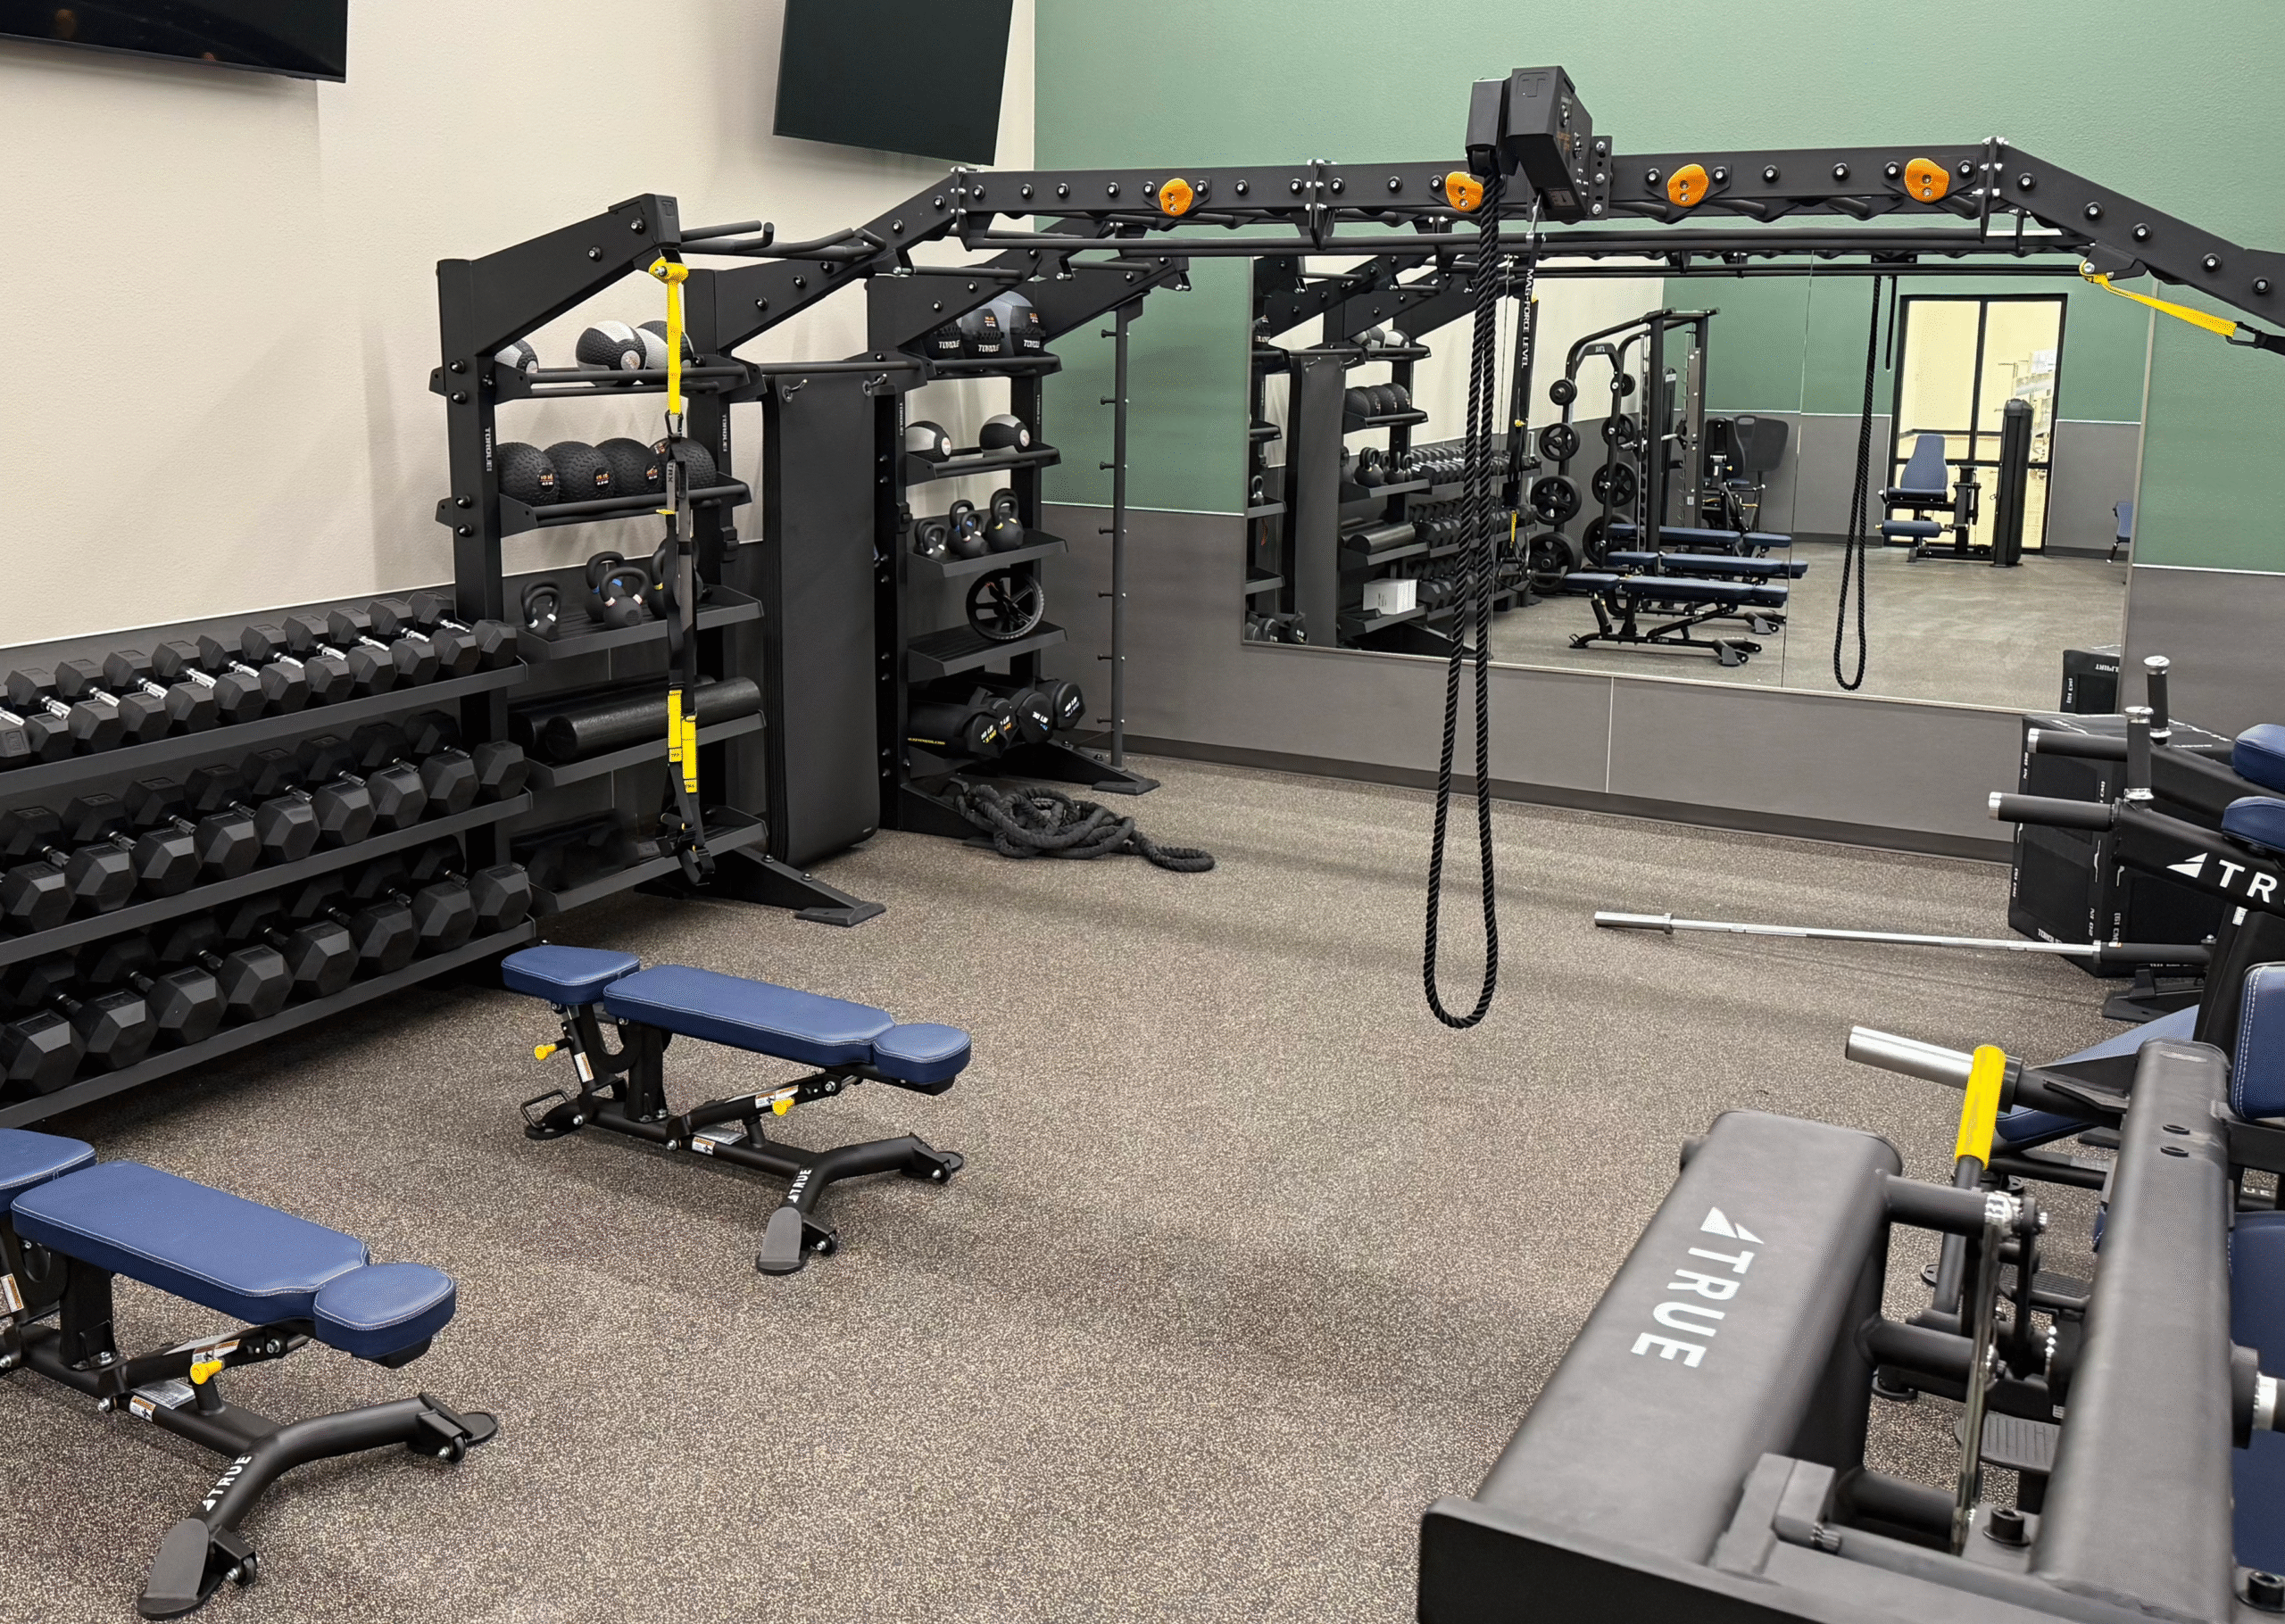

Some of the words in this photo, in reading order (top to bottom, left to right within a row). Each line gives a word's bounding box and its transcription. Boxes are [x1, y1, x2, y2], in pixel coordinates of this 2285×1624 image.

[1523, 268, 1534, 334] MAG-FORCE
[1521, 336, 1529, 369] LEVEL
[2218, 858, 2285, 905] TR
[789, 1168, 813, 1195] TRUE
[1630, 1247, 1756, 1369] TRUE
[206, 1455, 253, 1498] TRUE
